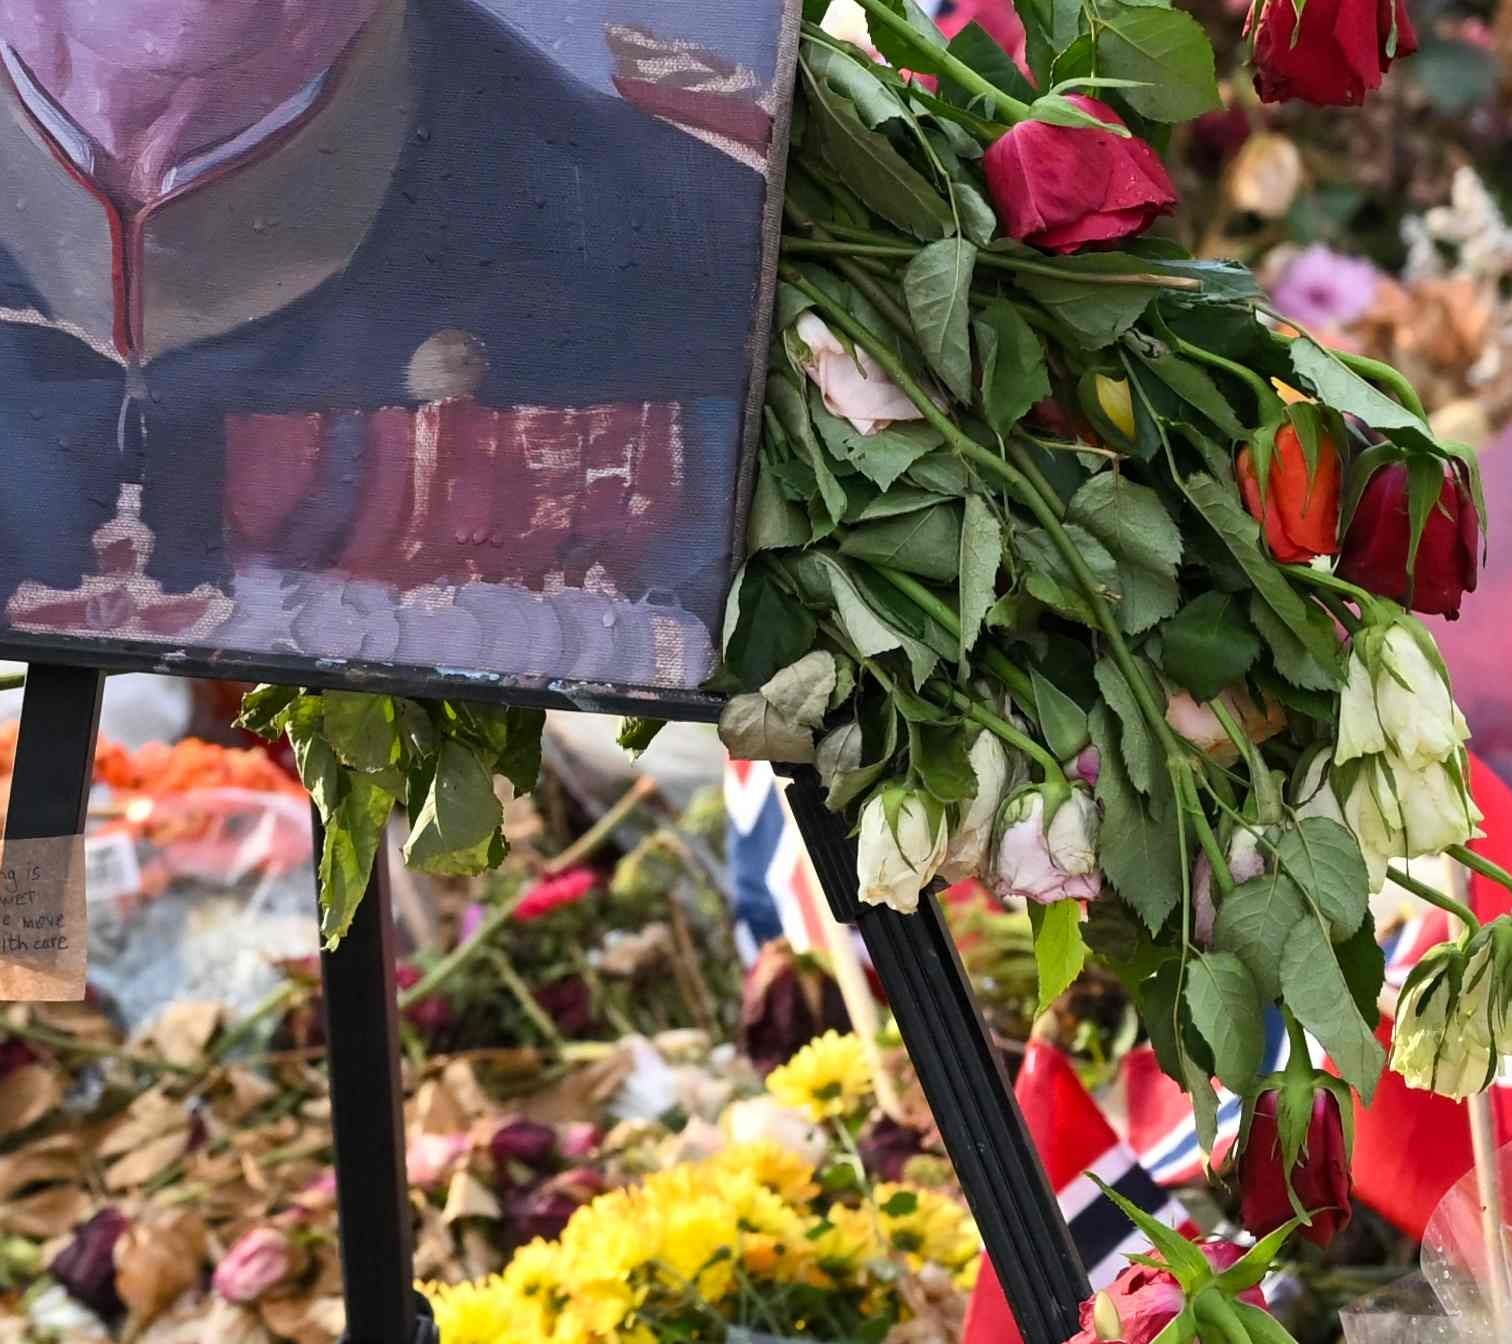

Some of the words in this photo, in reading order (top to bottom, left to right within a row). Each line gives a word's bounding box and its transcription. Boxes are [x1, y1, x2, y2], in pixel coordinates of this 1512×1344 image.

[26, 863, 41, 880] is
[22, 913, 64, 929] move
[33, 936, 69, 950] care
